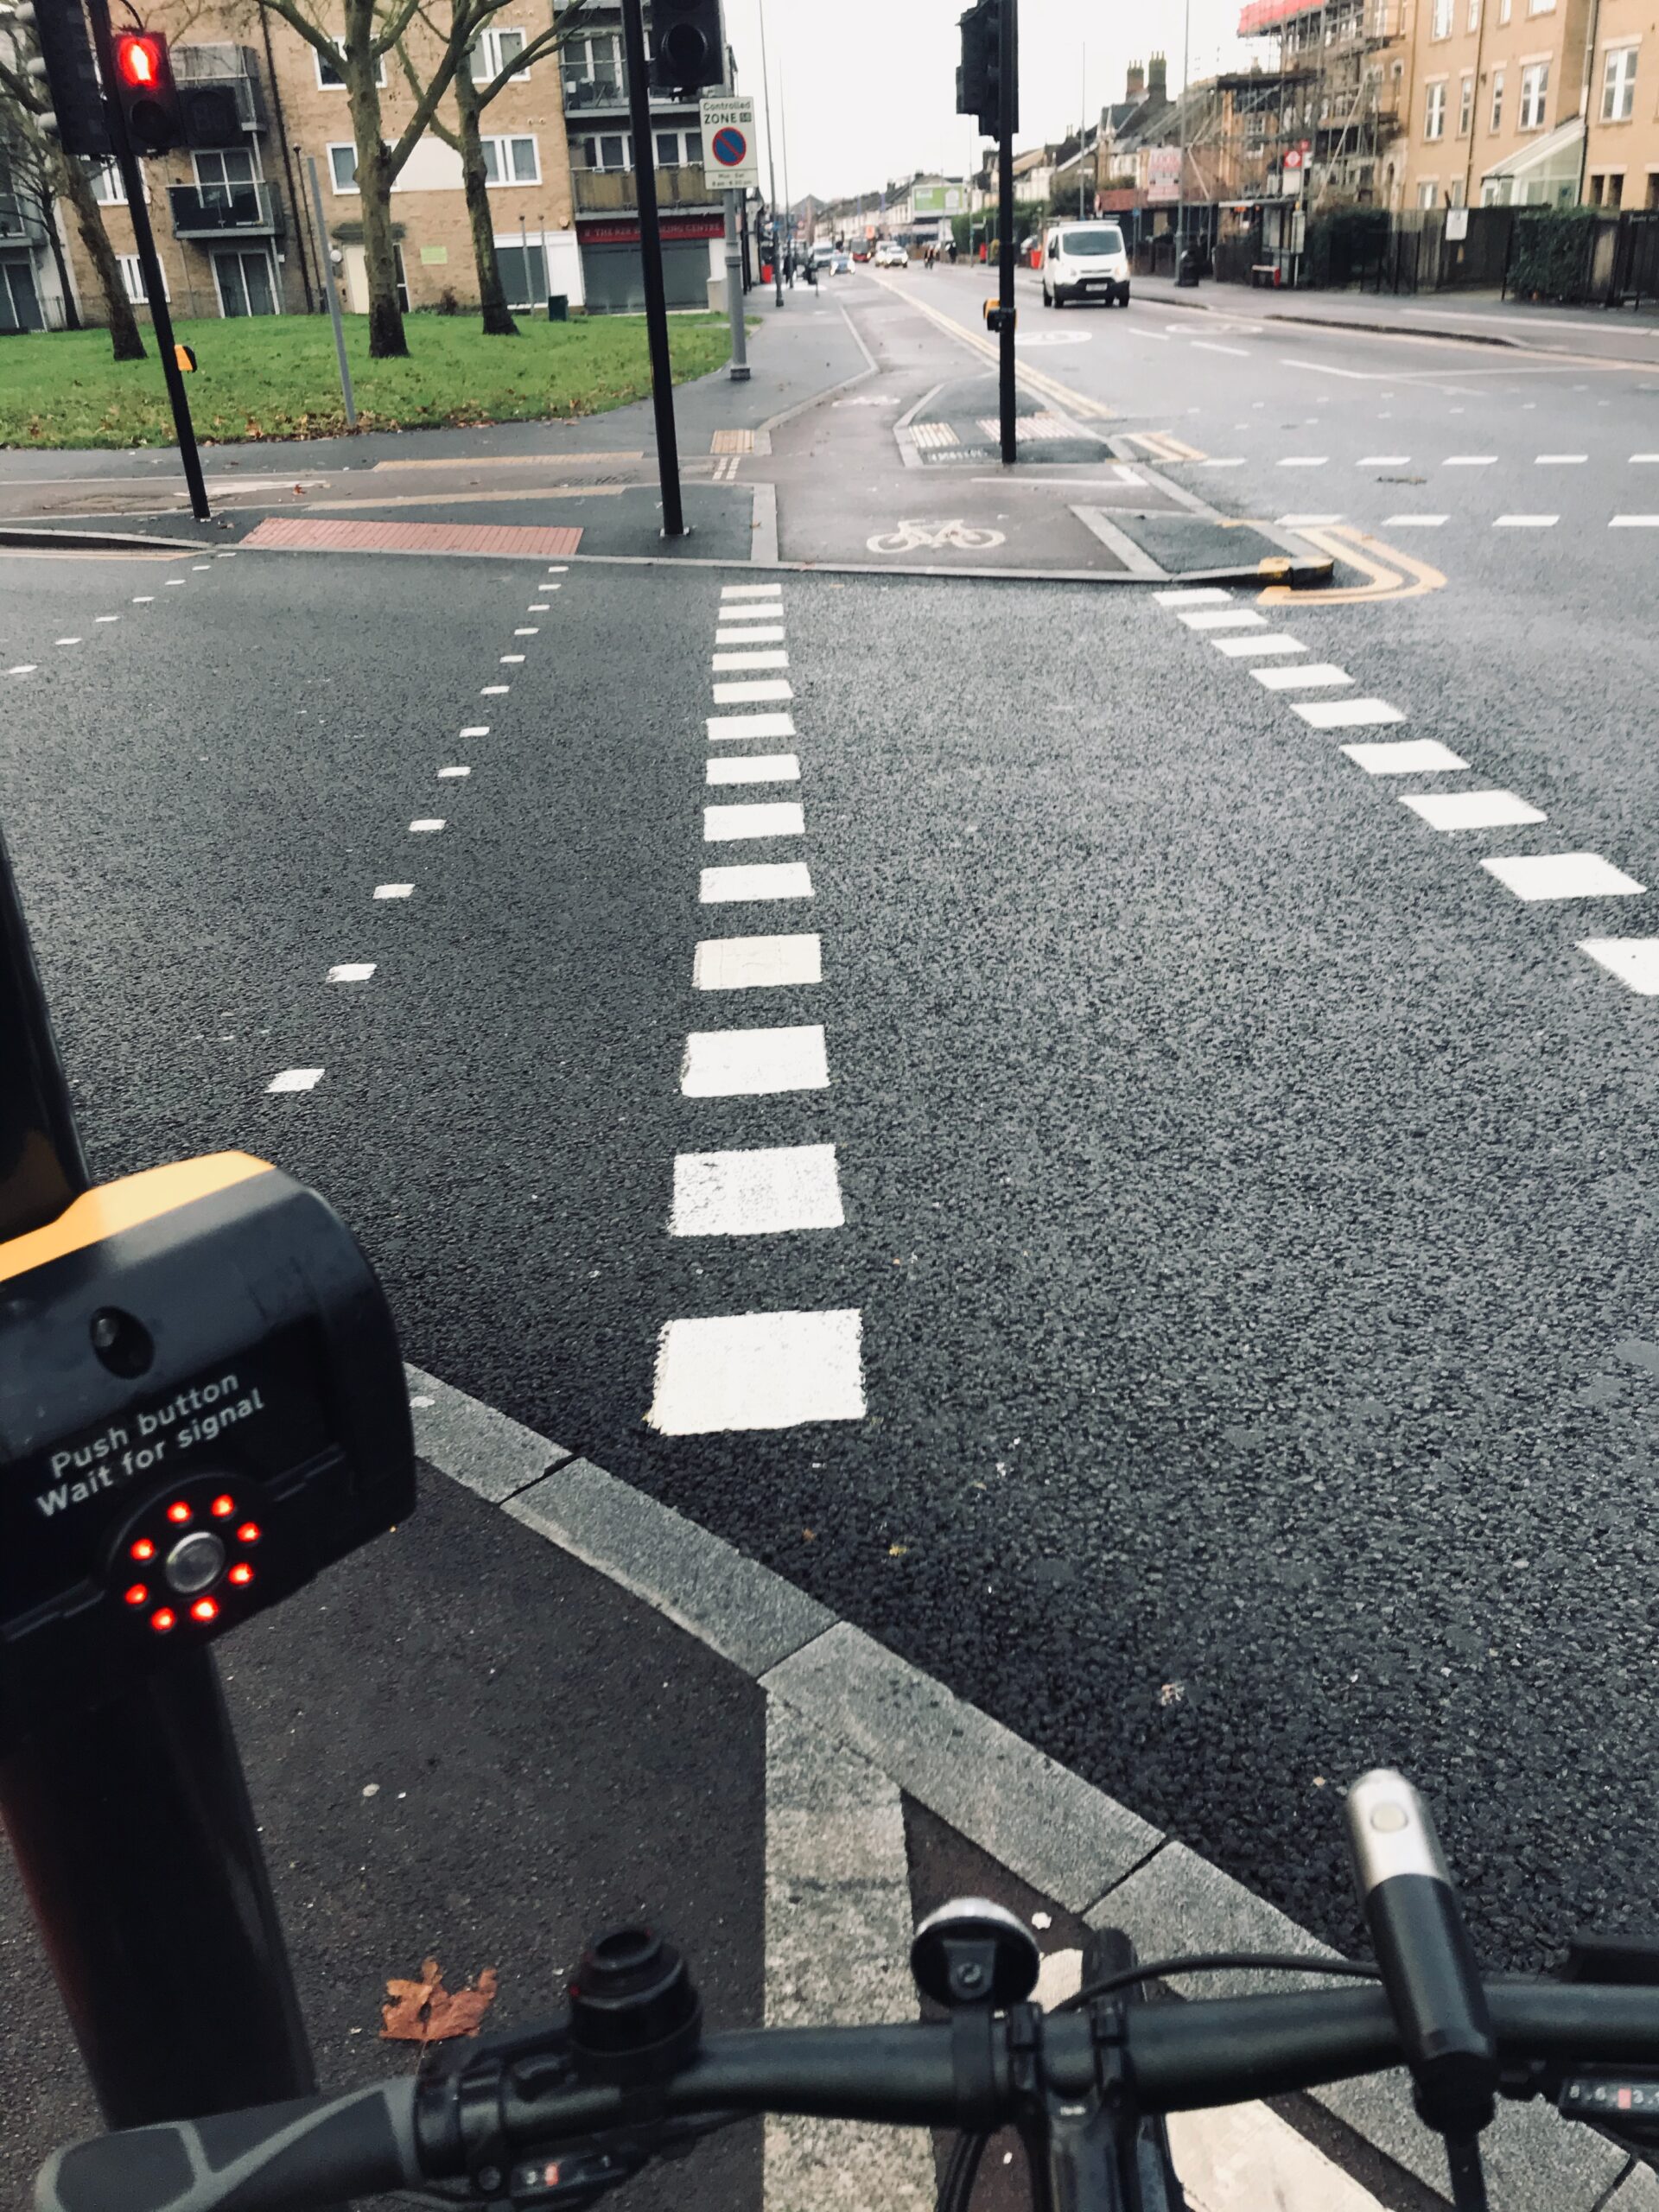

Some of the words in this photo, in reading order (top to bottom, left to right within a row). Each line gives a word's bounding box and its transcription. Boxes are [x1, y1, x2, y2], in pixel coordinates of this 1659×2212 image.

[703, 101, 751, 111] Controlled
[704, 113, 737, 124] ZONE
[35, 1466, 114, 1516] Wait
[121, 1440, 167, 1476] for
[177, 1388, 265, 1449] signal
[50, 1427, 130, 1478] Push
[137, 1373, 239, 1436] button
